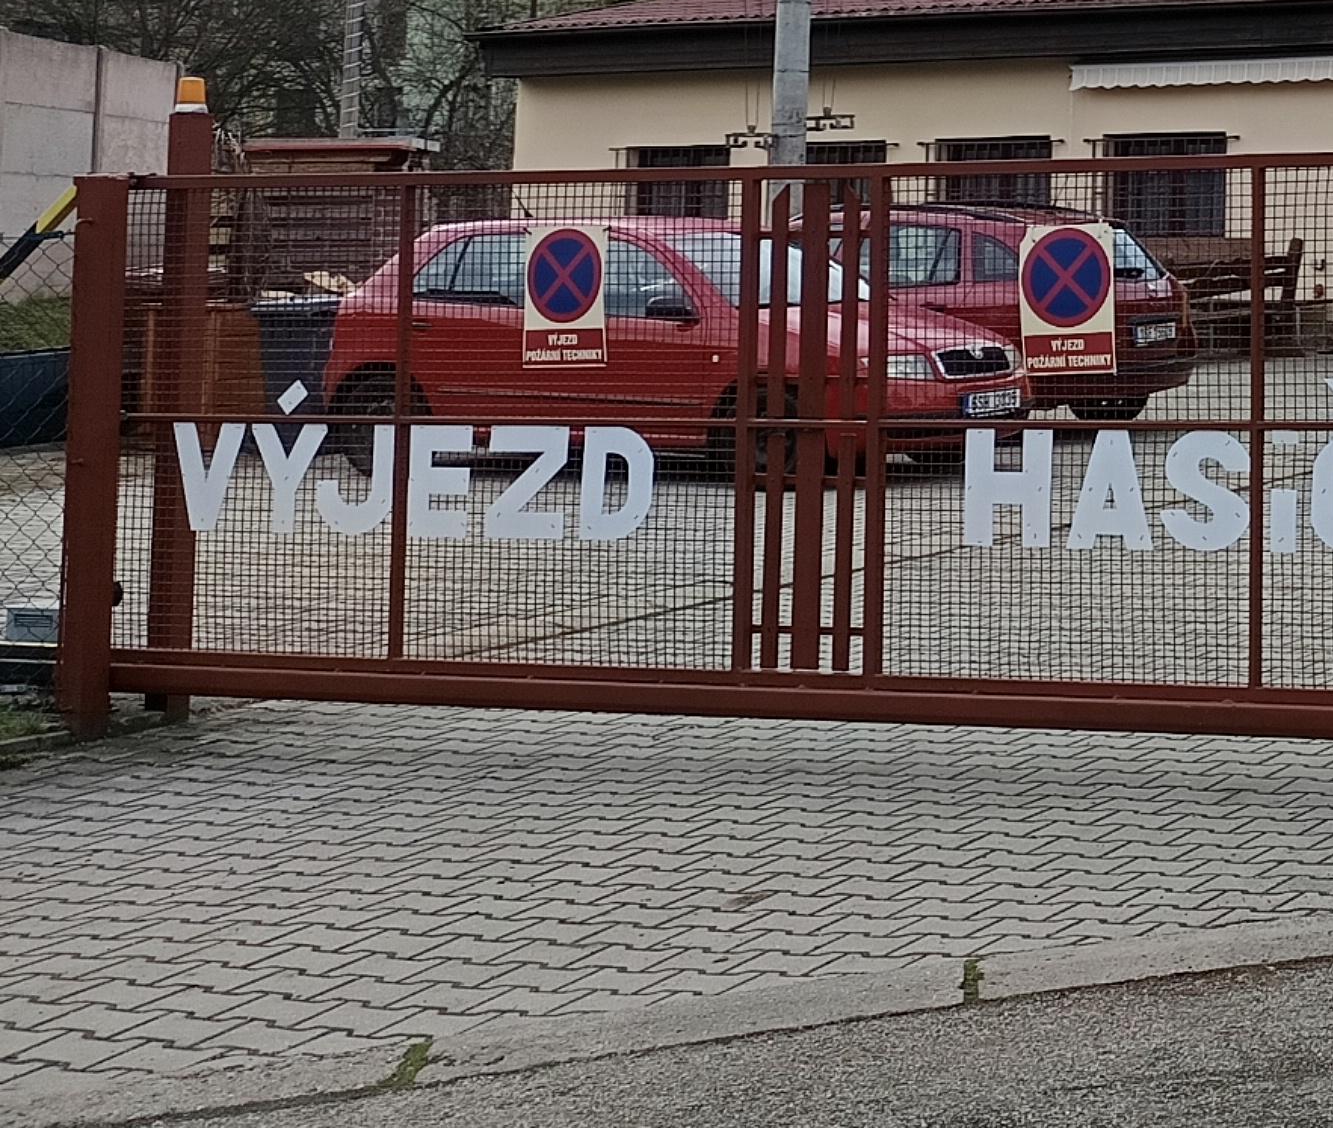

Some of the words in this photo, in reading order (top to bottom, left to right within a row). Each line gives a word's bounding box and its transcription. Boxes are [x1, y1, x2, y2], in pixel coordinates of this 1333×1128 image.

[1050, 336, 1086, 352] VÝJEZD
[1026, 352, 1066, 369] POŽÁRNÍ
[1067, 354, 1112, 367] TECHNIKY
[173, 379, 655, 541] VÝJEZD
